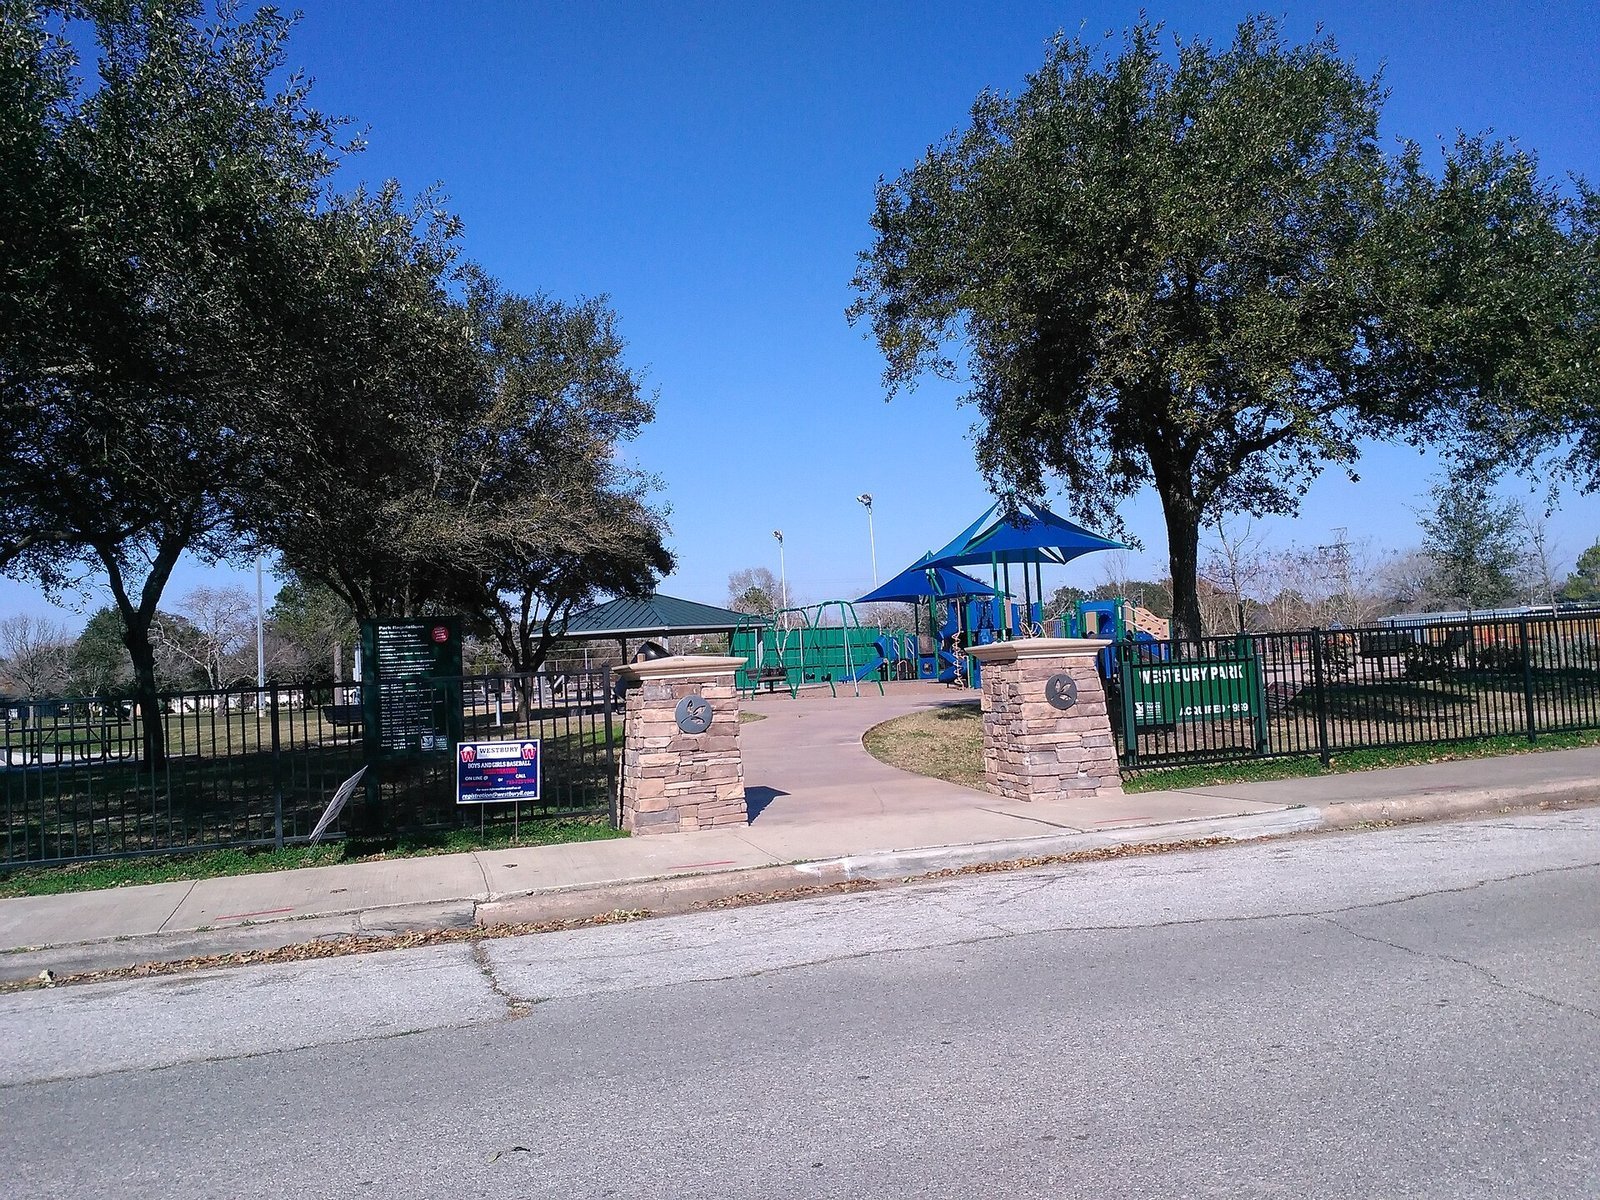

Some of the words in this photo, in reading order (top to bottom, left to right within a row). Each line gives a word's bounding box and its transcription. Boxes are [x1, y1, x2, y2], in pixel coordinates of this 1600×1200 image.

[1139, 667, 1207, 684] WESTBURY
[1210, 665, 1243, 680] PARK
[1227, 703, 1249, 712] 959
